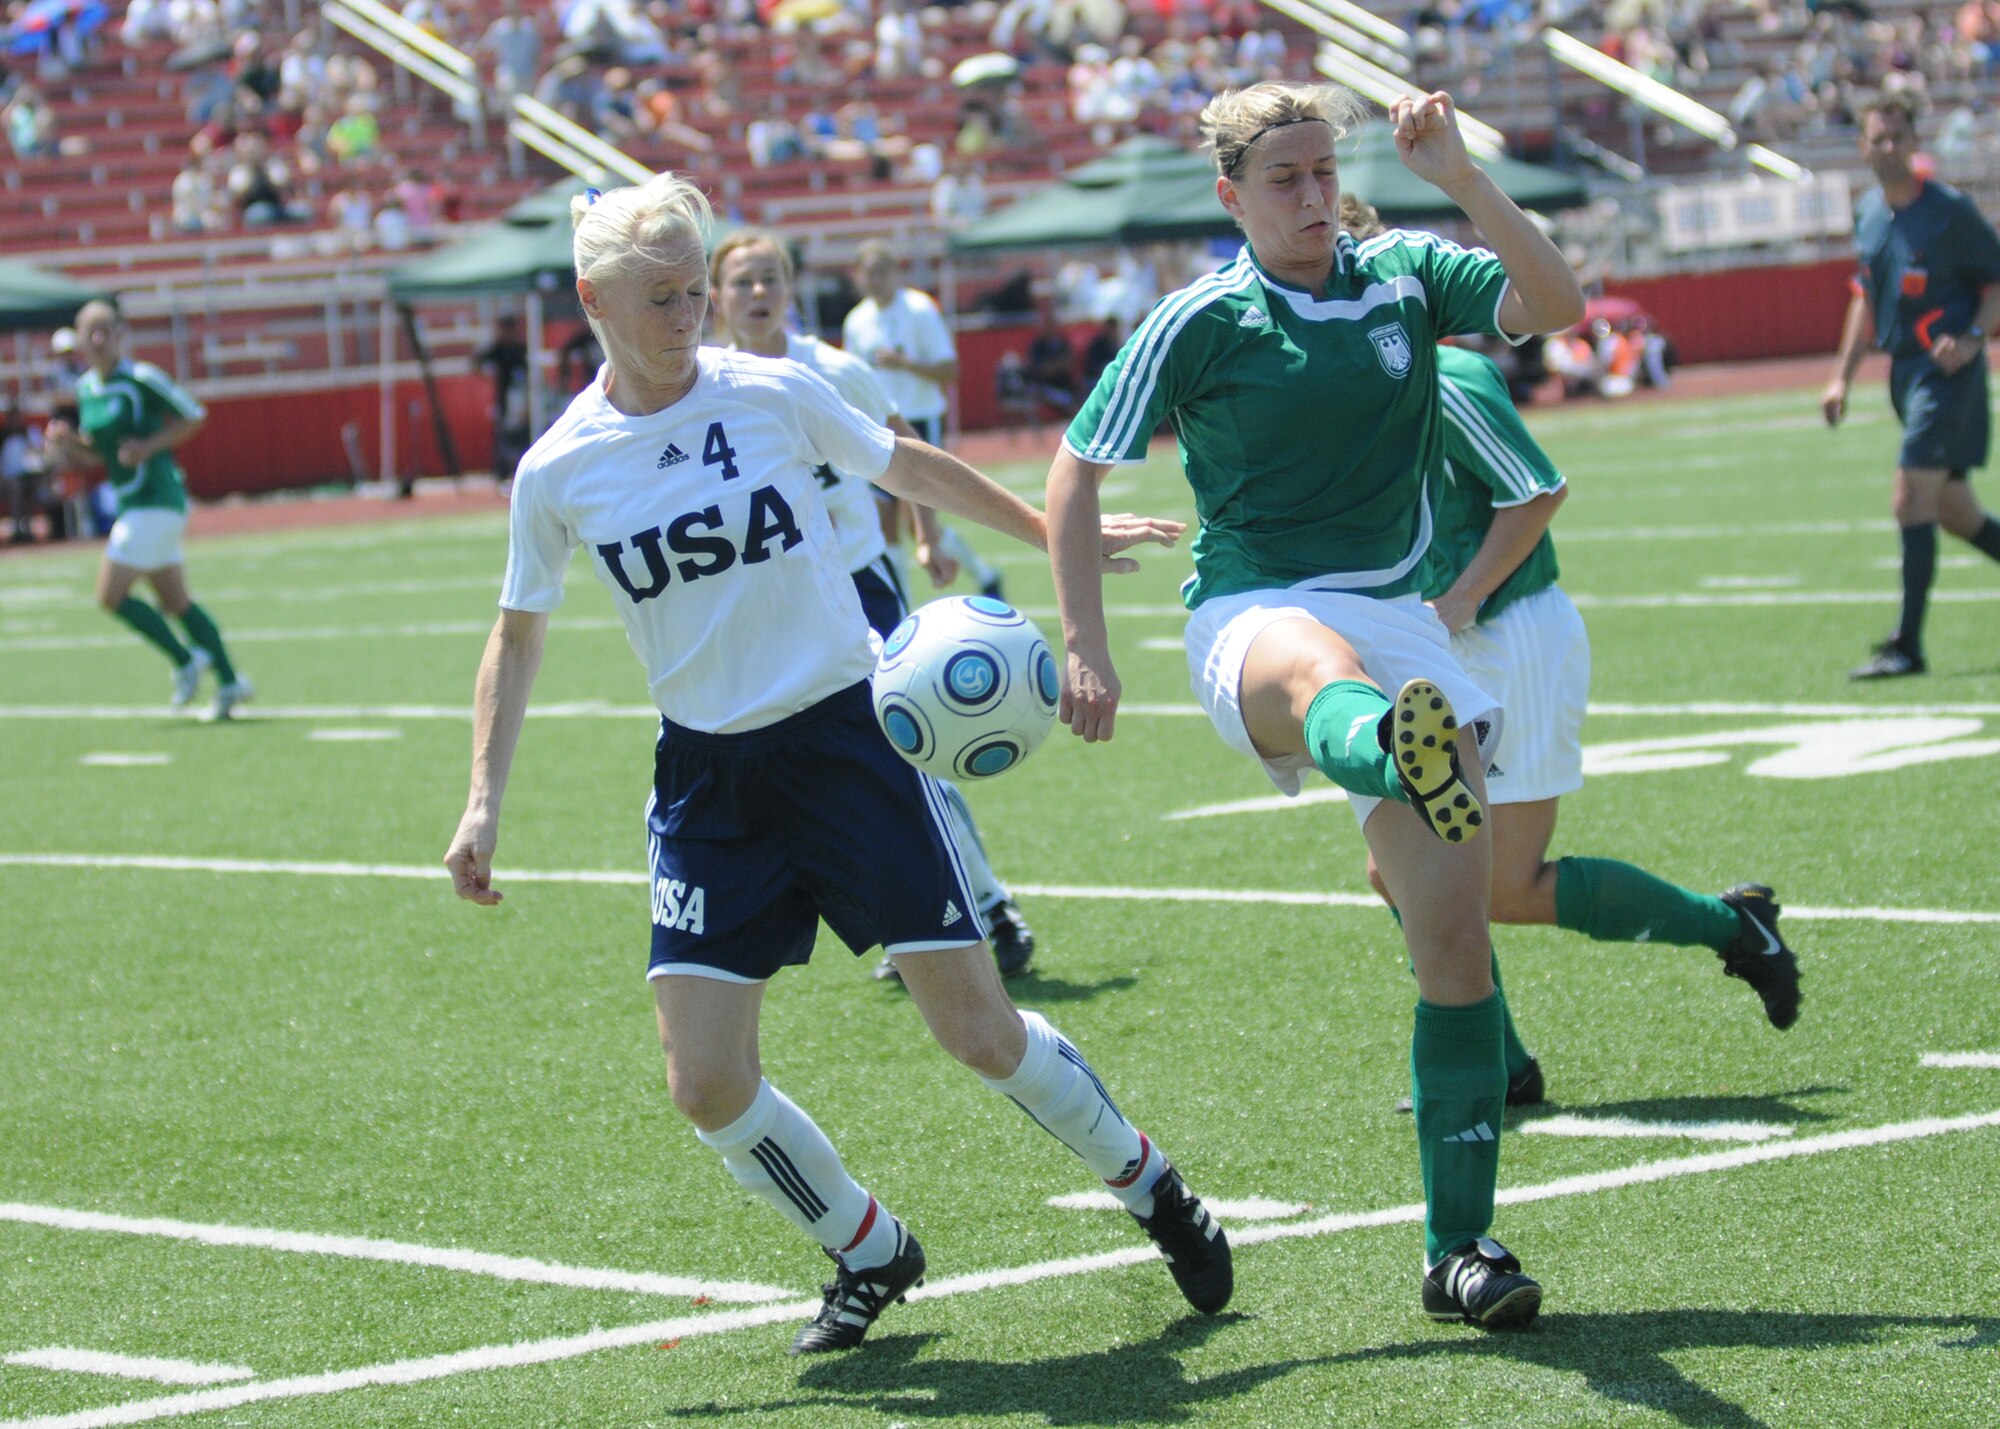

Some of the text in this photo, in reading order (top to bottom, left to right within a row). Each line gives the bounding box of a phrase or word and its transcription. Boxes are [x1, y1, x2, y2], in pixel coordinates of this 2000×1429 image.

[657, 453, 690, 469] adidas
[702, 421, 739, 481] 4
[597, 484, 804, 604] USA
[652, 877, 704, 935] USA
